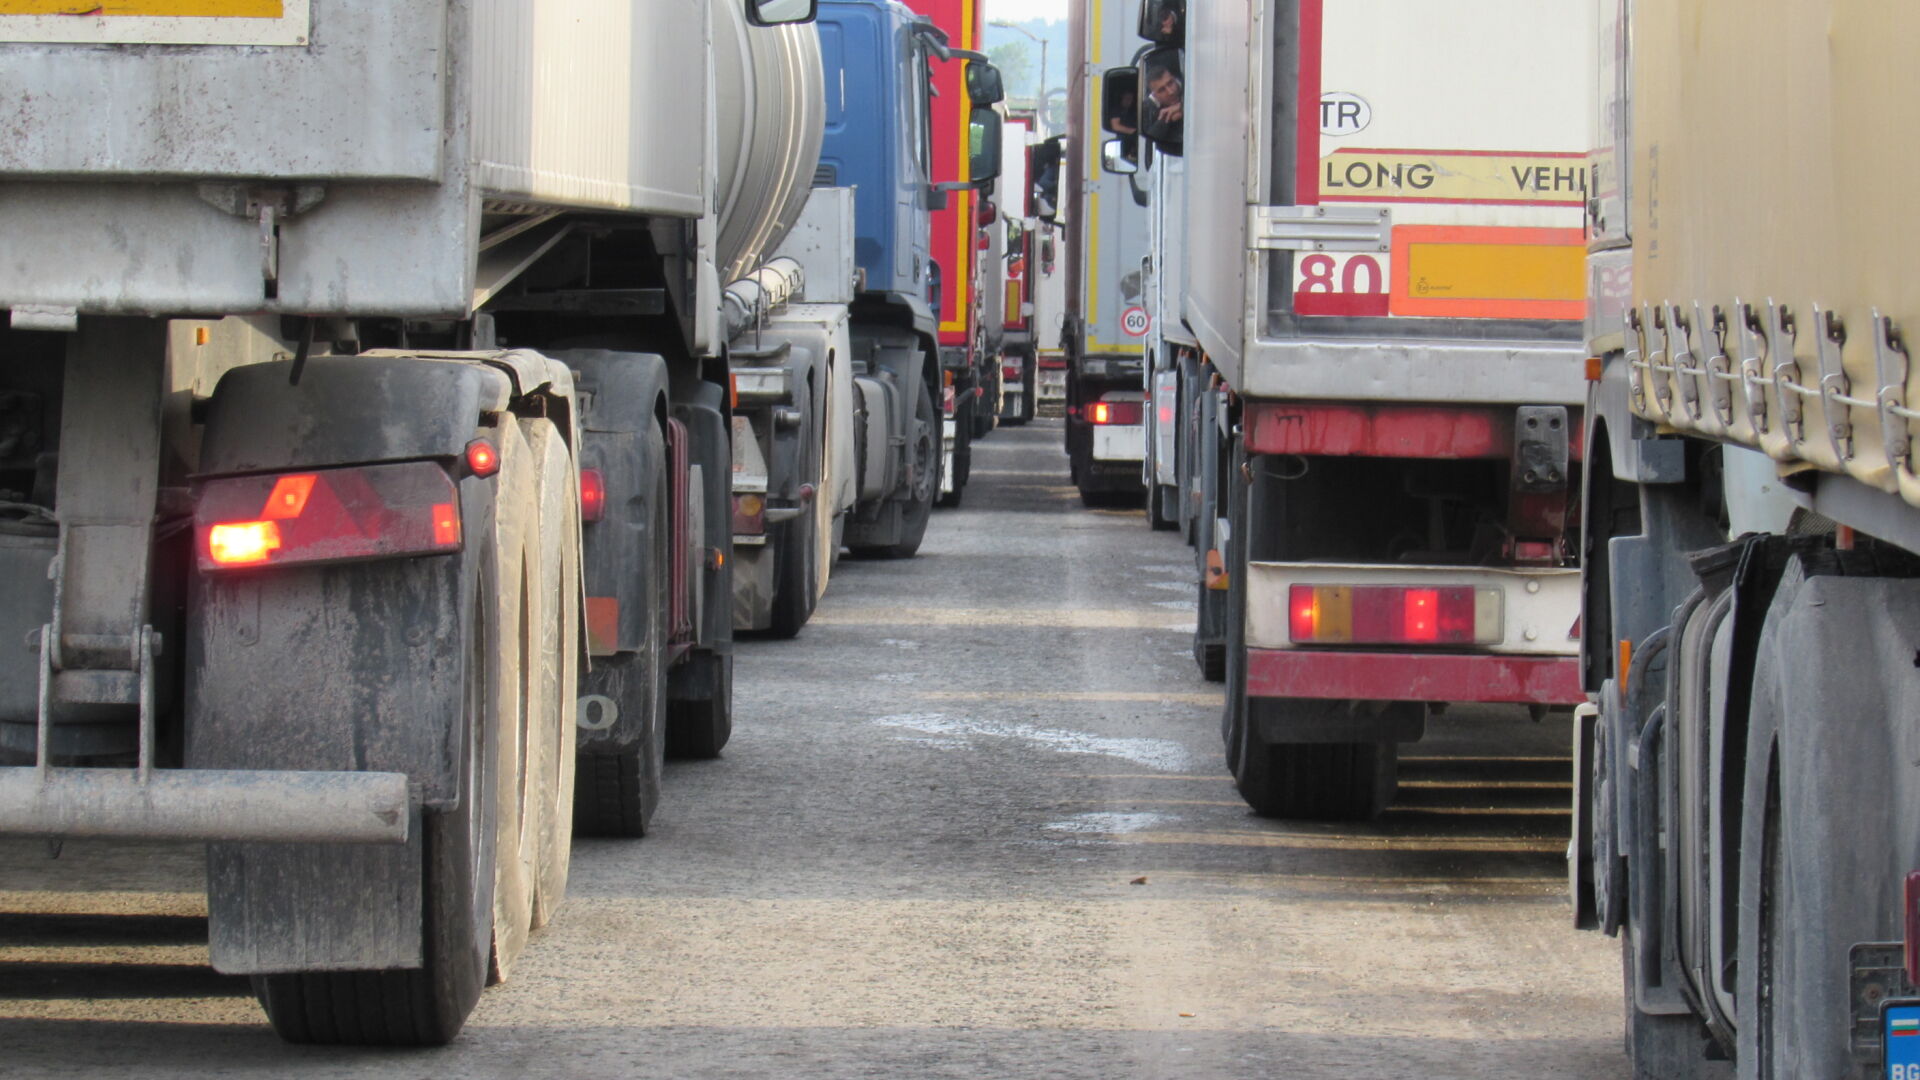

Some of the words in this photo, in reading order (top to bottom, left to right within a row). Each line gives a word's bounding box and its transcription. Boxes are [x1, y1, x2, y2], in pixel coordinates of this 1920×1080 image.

[1320, 101, 1361, 128] TR
[1326, 162, 1435, 189] LONG
[1298, 254, 1382, 293] 80
[1127, 315, 1146, 328] 60
[1891, 1063, 1920, 1080] BG
